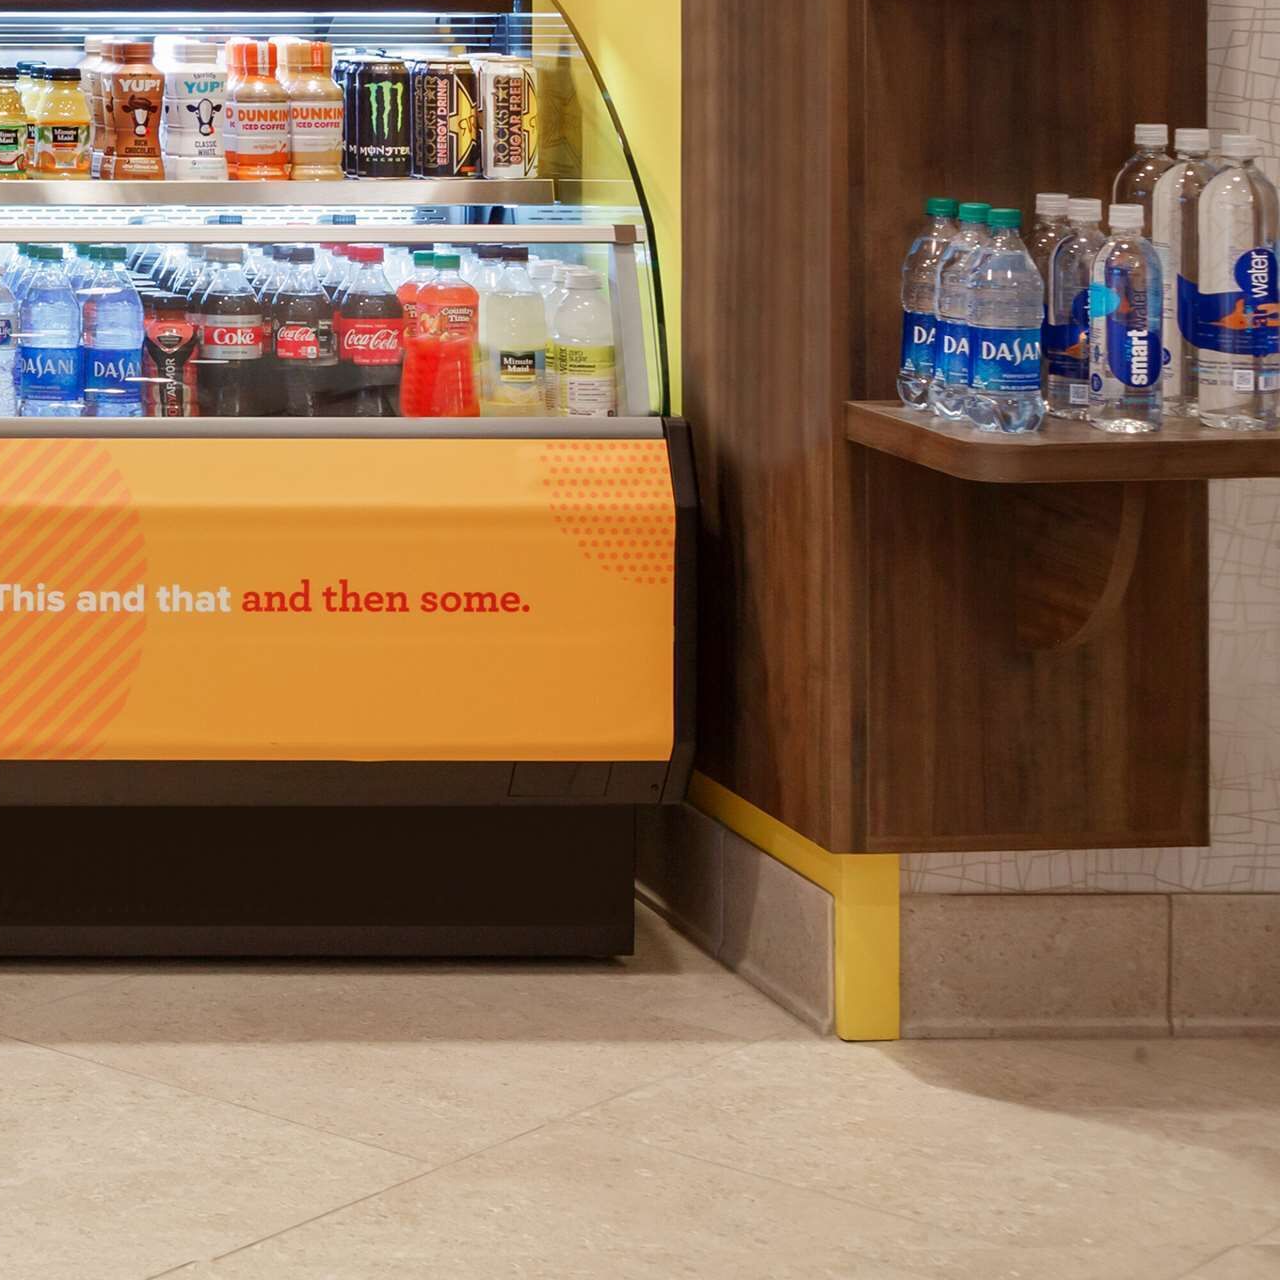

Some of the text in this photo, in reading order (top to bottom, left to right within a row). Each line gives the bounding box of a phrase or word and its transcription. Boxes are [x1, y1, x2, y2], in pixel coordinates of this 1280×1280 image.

[119, 79, 160, 93] YUP!
[184, 81, 225, 94] YUP!
[242, 123, 258, 131] ICED
[296, 121, 313, 129] ICED
[437, 77, 449, 166] ENERGY DRINK
[509, 77, 522, 165] SUGAR FREE
[124, 146, 157, 154] CHOCOLATE
[194, 141, 217, 149] CLASSIC
[197, 148, 217, 156] WHITE
[1248, 252, 1269, 298] water
[441, 307, 474, 317] Country
[448, 314, 470, 323] Time
[213, 328, 255, 345] Coke
[277, 326, 317, 341] Coca-Cola
[345, 329, 401, 351] Coca-Cola
[503, 357, 534, 365] Minute
[507, 364, 530, 372] Maid
[166, 358, 176, 416] ODYARMOR
[76, 583, 144, 614] and
[156, 583, 231, 613] that
[241, 580, 312, 614] and
[322, 580, 410, 614] then
[419, 589, 530, 614] some.
